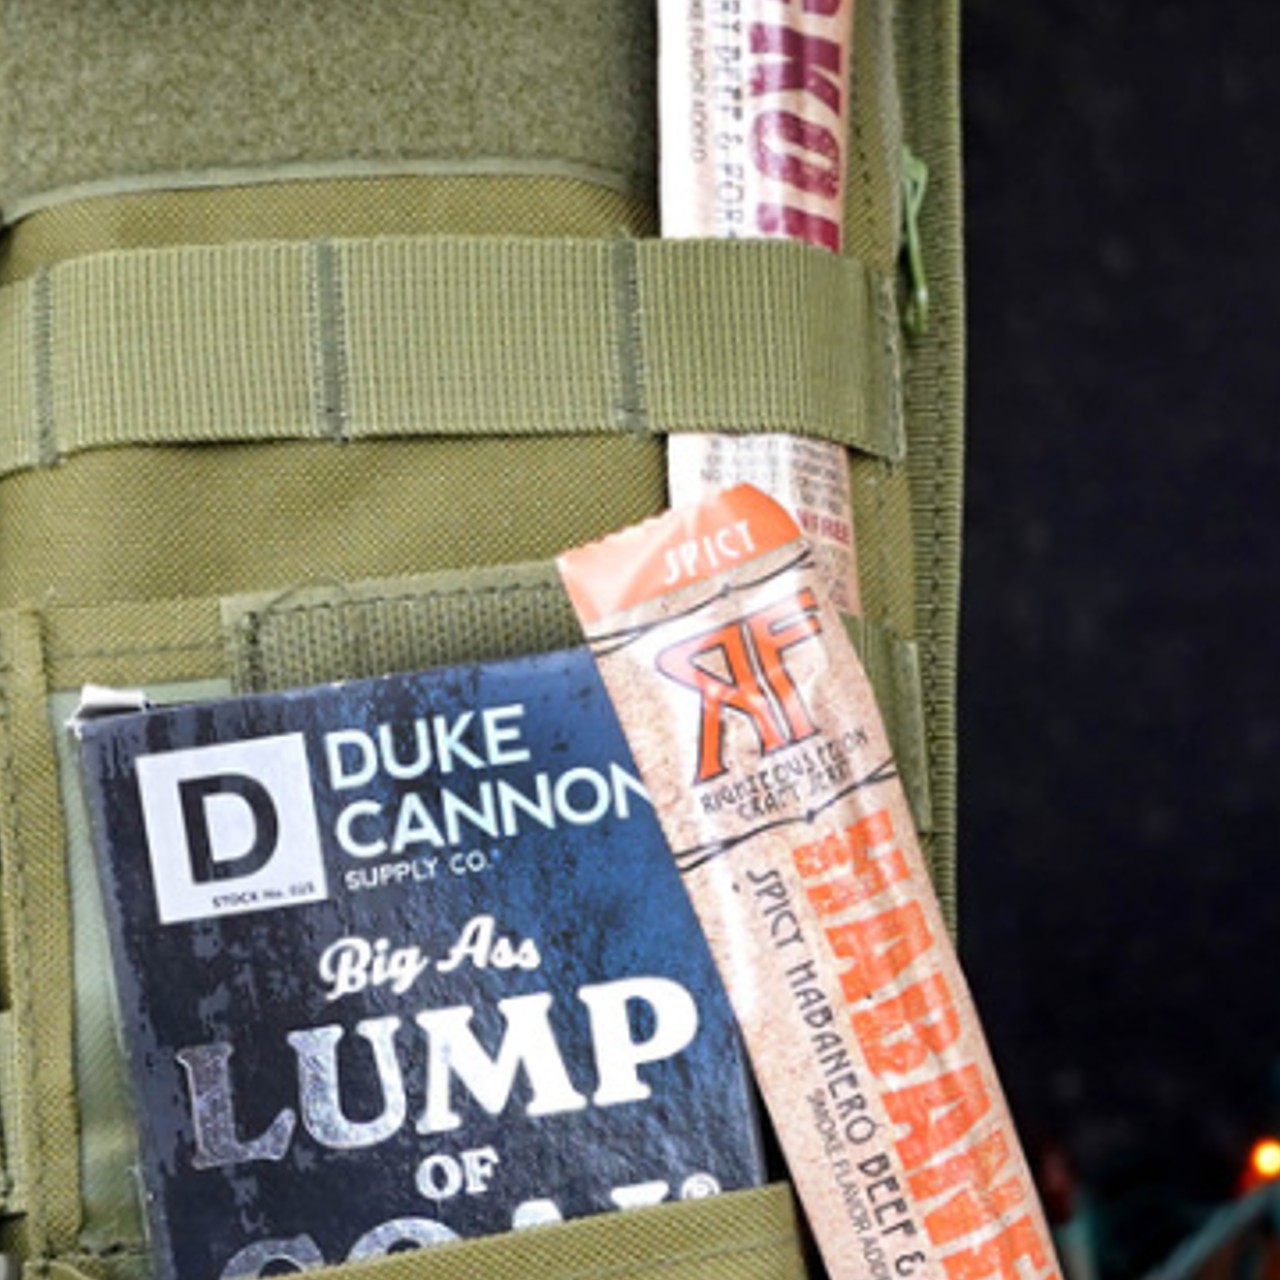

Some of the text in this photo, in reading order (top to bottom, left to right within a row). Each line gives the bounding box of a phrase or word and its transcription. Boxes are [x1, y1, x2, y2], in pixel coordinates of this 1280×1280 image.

[324, 705, 531, 790] DUKE
[177, 771, 280, 886] D
[344, 856, 439, 890] SUPPLY
[320, 915, 543, 1000] Big Ass
[175, 976, 699, 1170] LUMP
[786, 959, 877, 1147] HABANERO
[858, 1151, 918, 1241] BEEF
[894, 1249, 926, 1278] &
[417, 1147, 500, 1203] OF
[832, 1158, 870, 1236] FLAVOR
